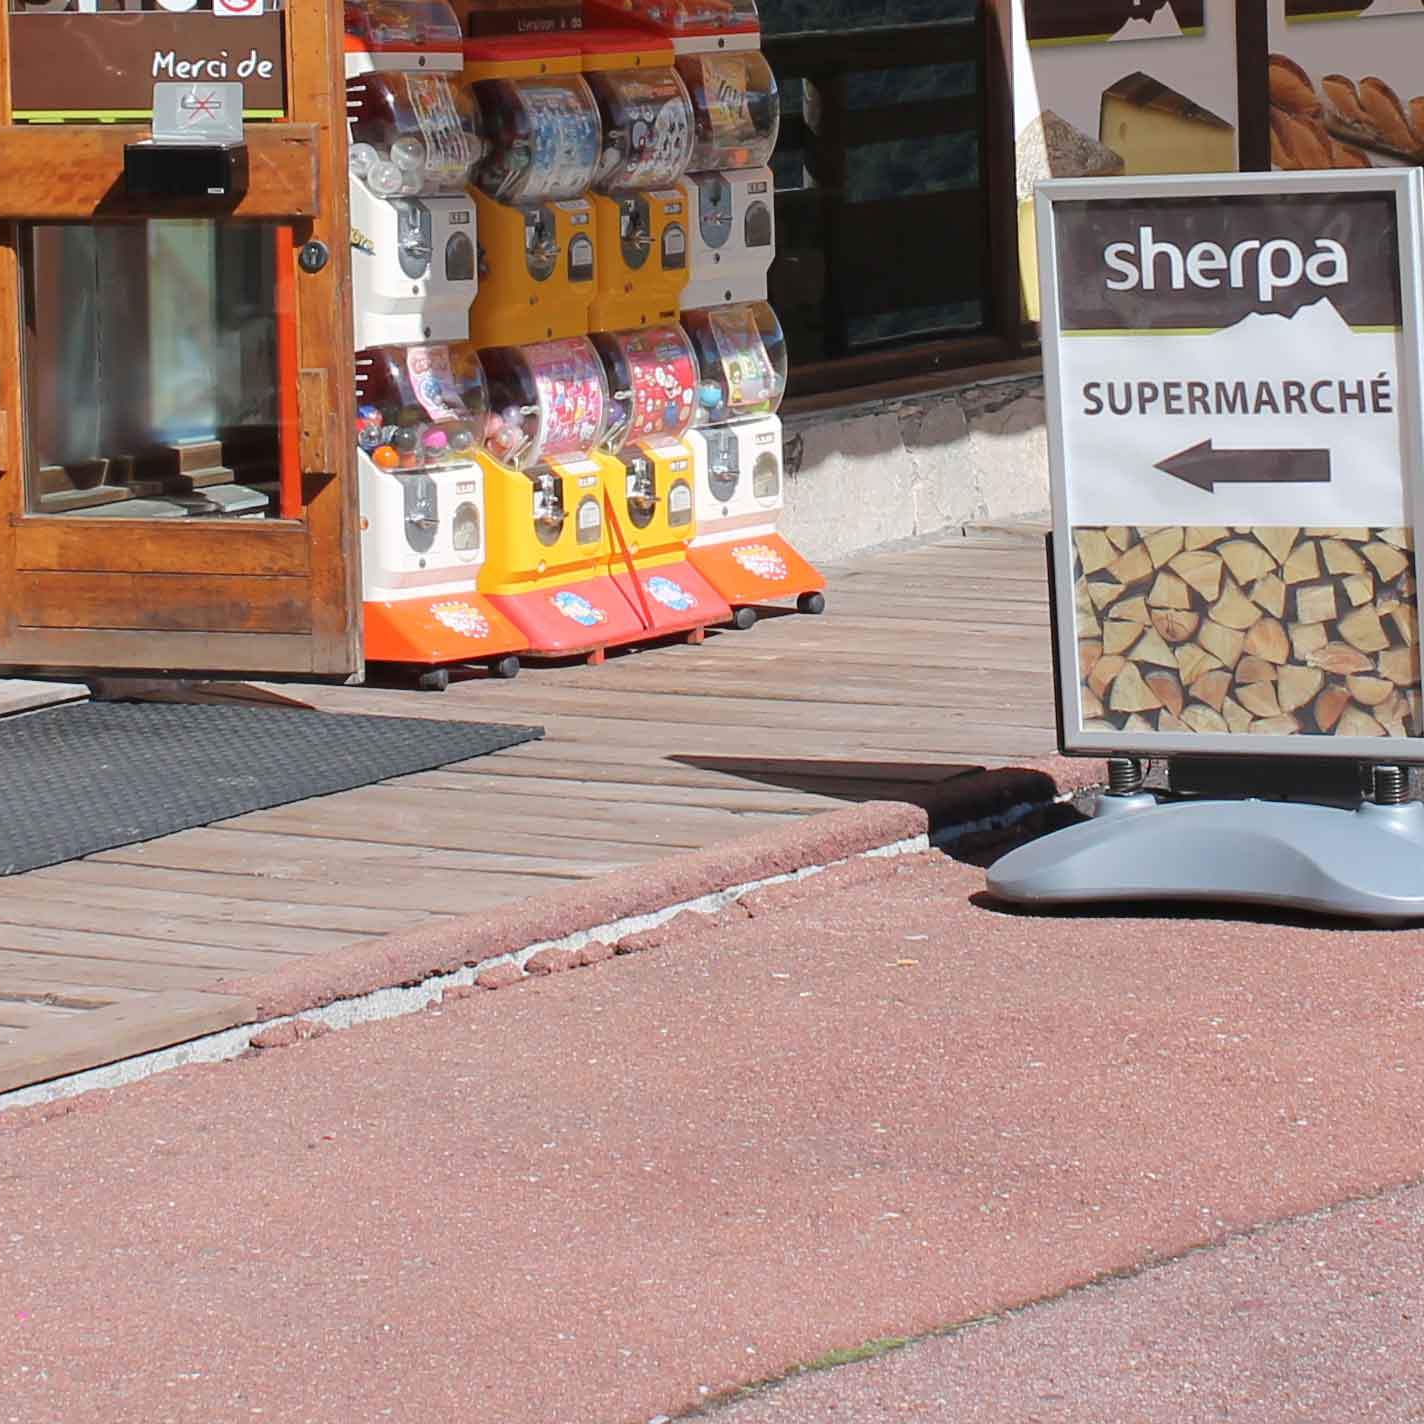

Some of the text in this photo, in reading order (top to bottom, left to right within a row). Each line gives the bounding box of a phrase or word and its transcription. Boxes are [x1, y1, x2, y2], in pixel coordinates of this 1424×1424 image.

[152, 49, 273, 78] Merci de
[1104, 226, 1349, 301] sherpa
[1082, 371, 1394, 416] SUPERMARCHÉ
